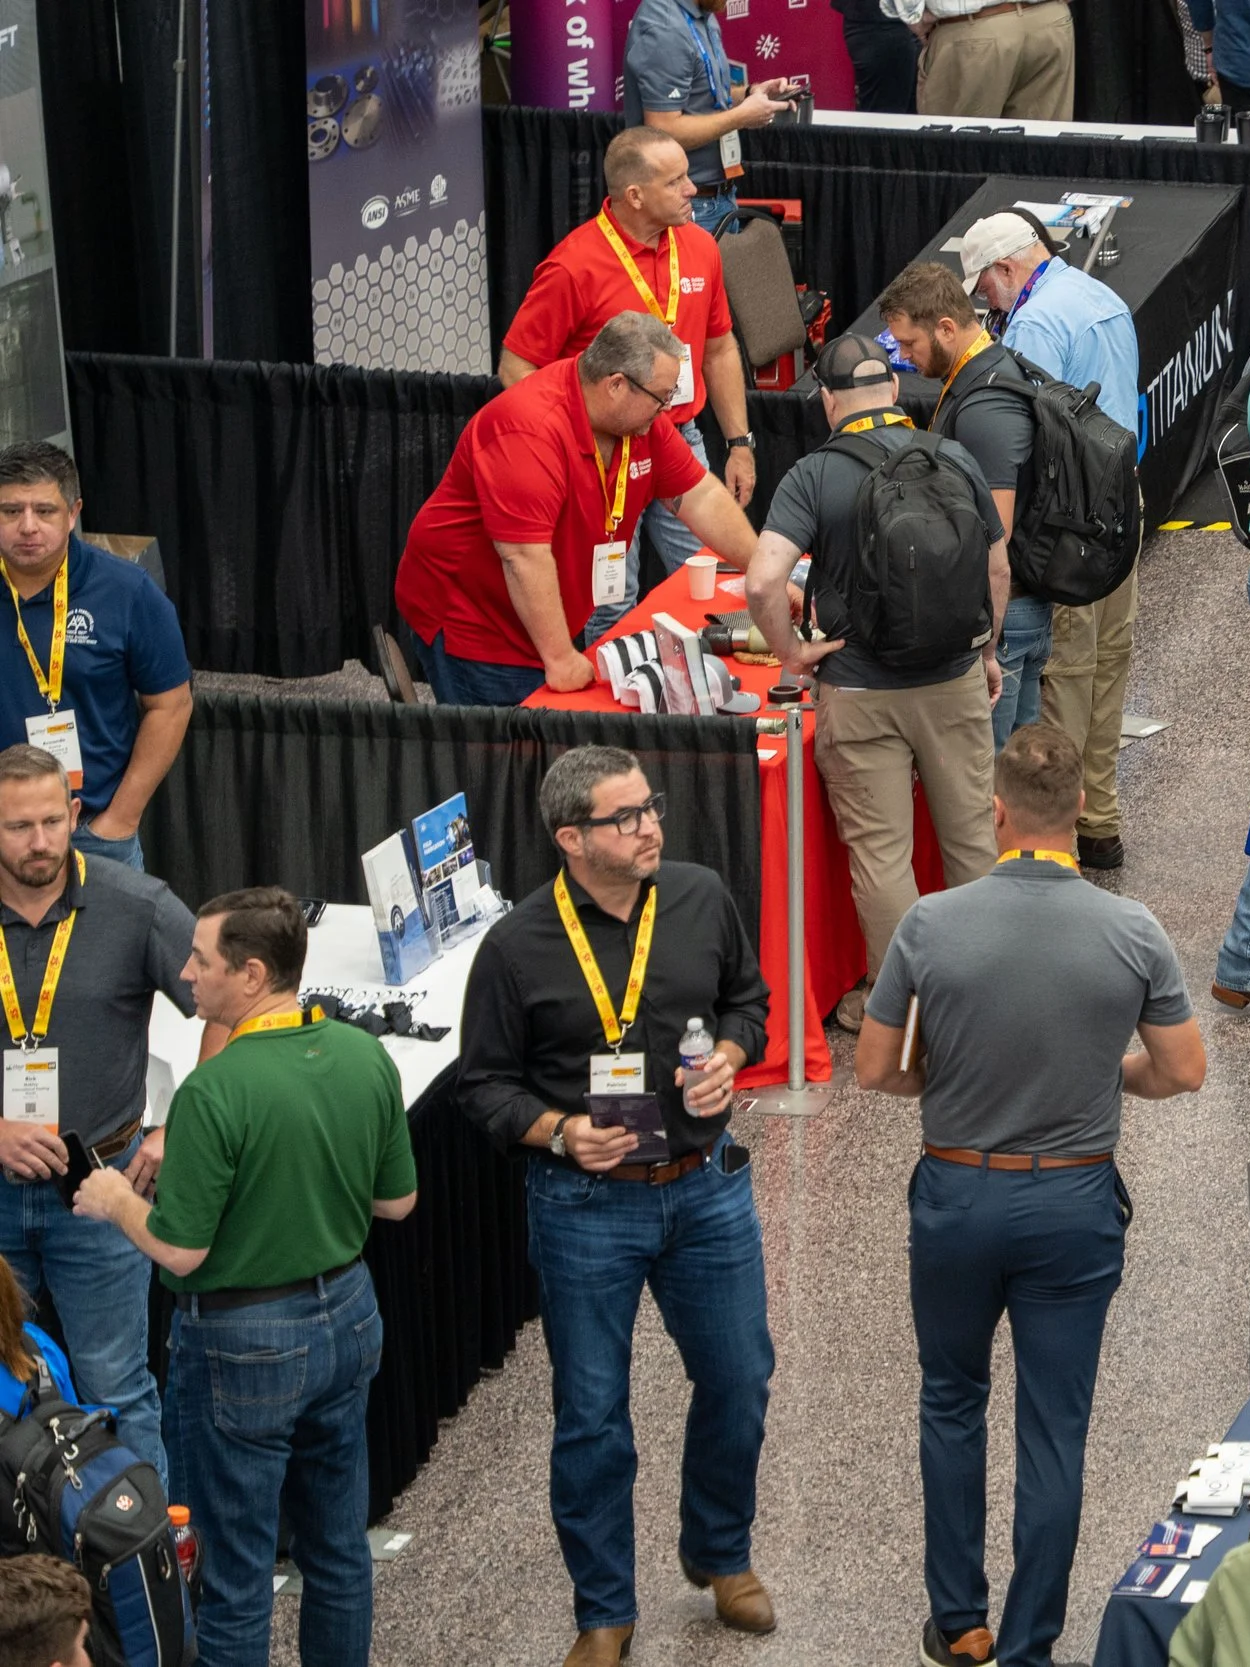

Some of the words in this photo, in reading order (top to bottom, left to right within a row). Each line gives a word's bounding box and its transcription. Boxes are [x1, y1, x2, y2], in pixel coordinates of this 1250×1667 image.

[566, 16, 595, 49] of
[568, 57, 596, 112] wh
[366, 207, 386, 224] ANSI
[394, 188, 421, 210] ASME
[1147, 288, 1233, 446] TITANIUM
